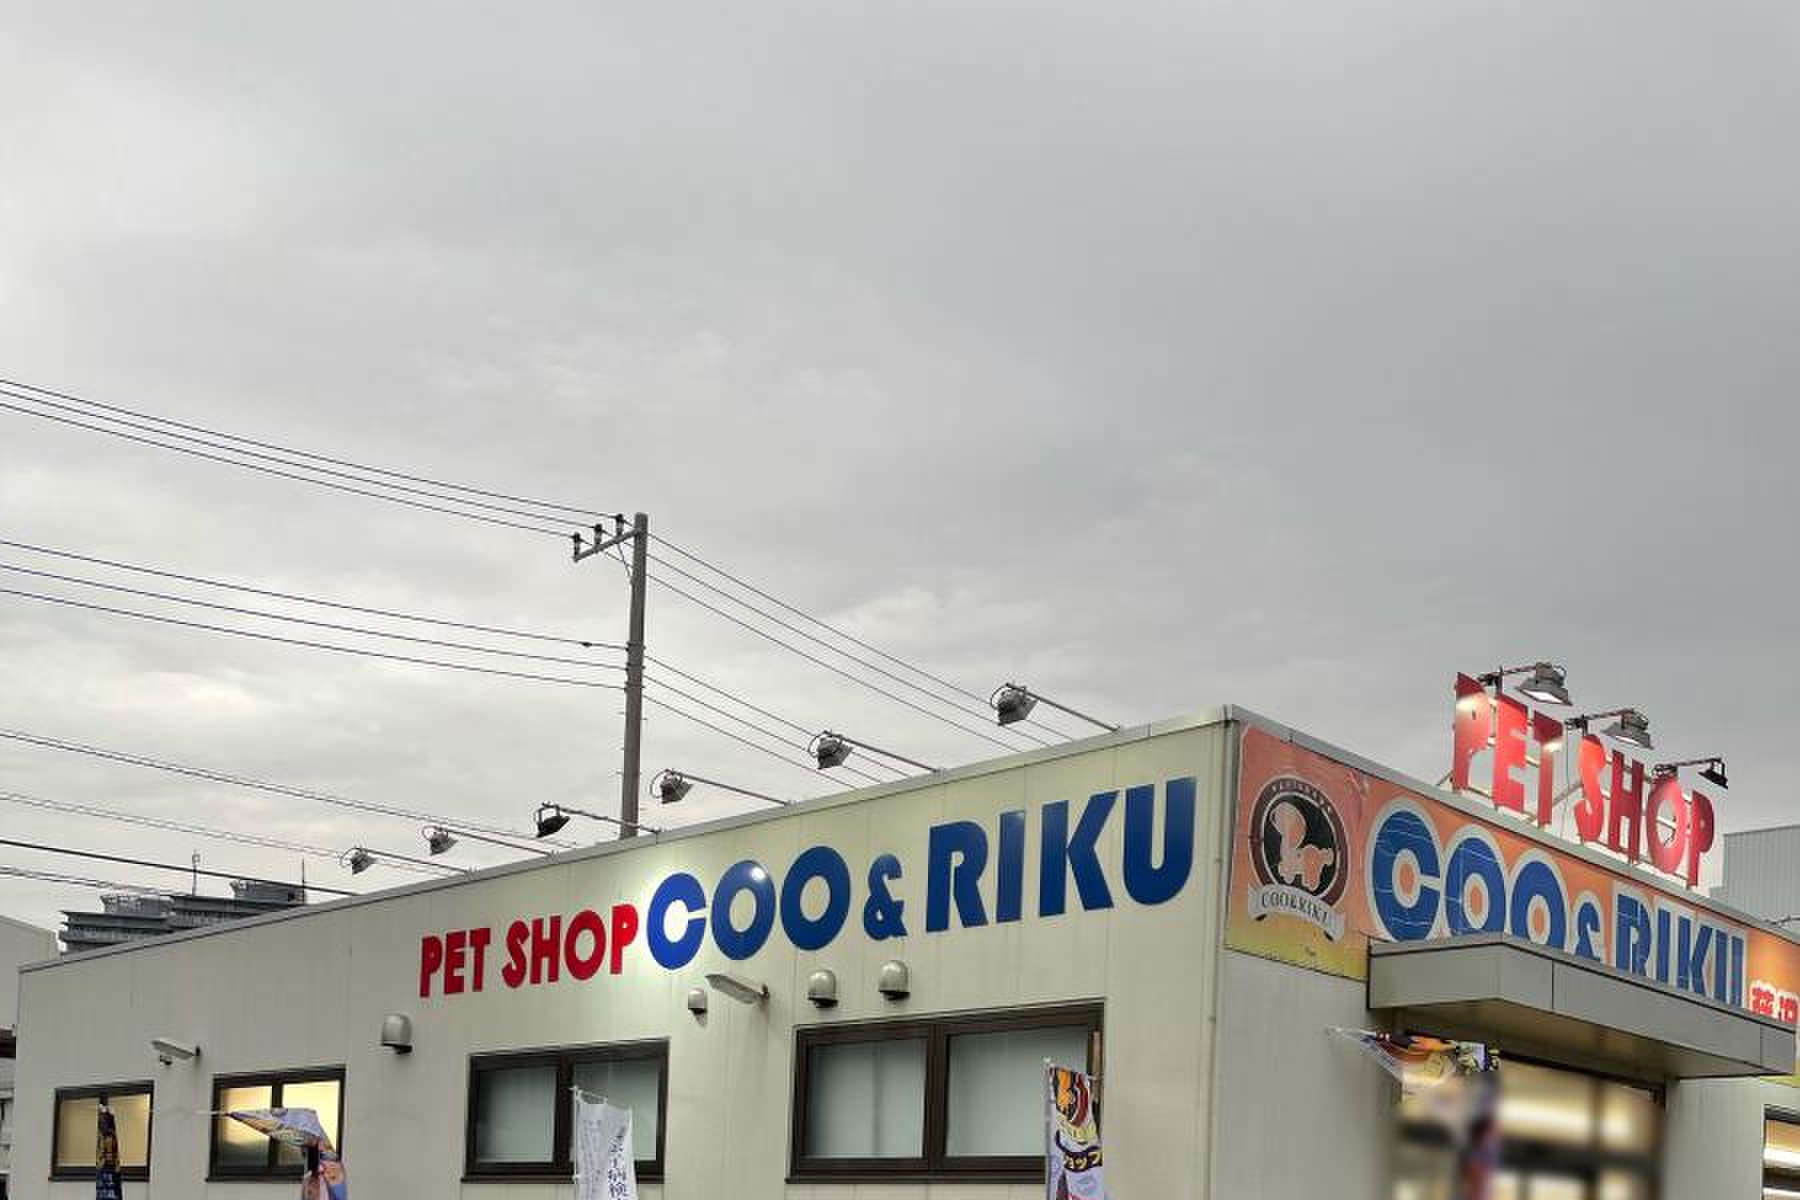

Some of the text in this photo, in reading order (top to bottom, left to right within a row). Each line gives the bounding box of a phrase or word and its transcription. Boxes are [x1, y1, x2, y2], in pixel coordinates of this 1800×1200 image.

[419, 927, 491, 998] PET
[502, 904, 639, 989] SHOP
[647, 845, 849, 970] COO
[862, 853, 908, 941] &
[925, 776, 1197, 932] RIKU
[1372, 809, 1567, 952] COO
[1453, 672, 1714, 887] PET SHOP
